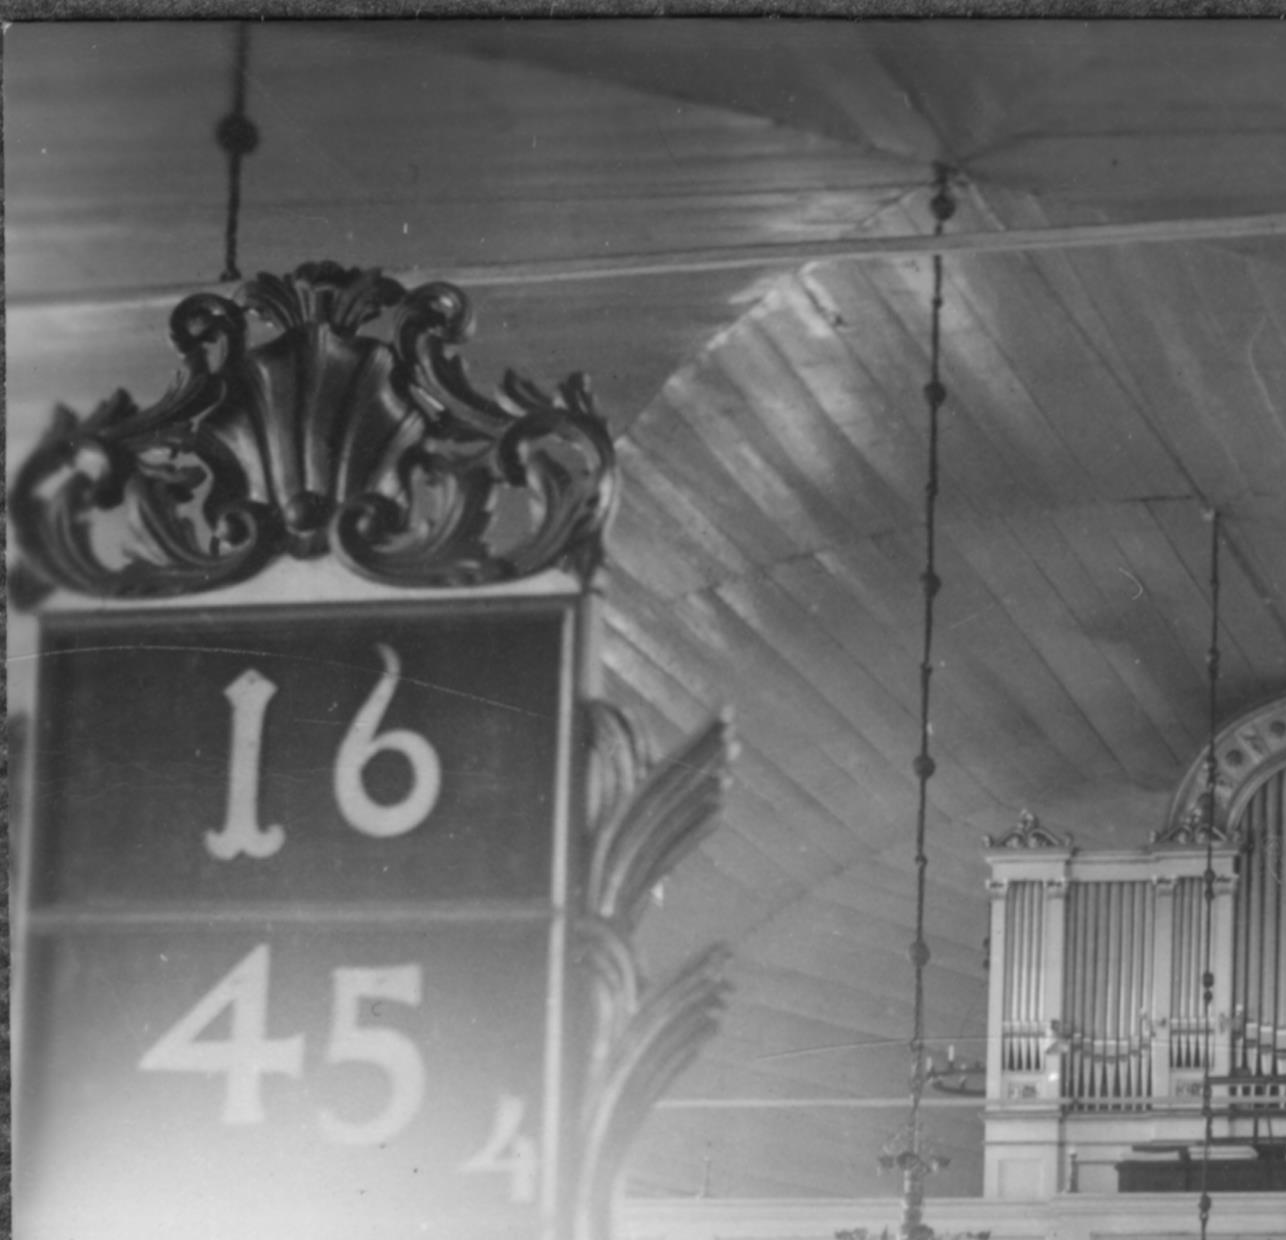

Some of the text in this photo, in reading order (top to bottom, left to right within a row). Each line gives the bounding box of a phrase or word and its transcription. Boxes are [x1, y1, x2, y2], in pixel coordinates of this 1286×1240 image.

[204, 641, 442, 861] 16
[137, 942, 427, 1145] 45
[456, 1094, 540, 1203] 4
